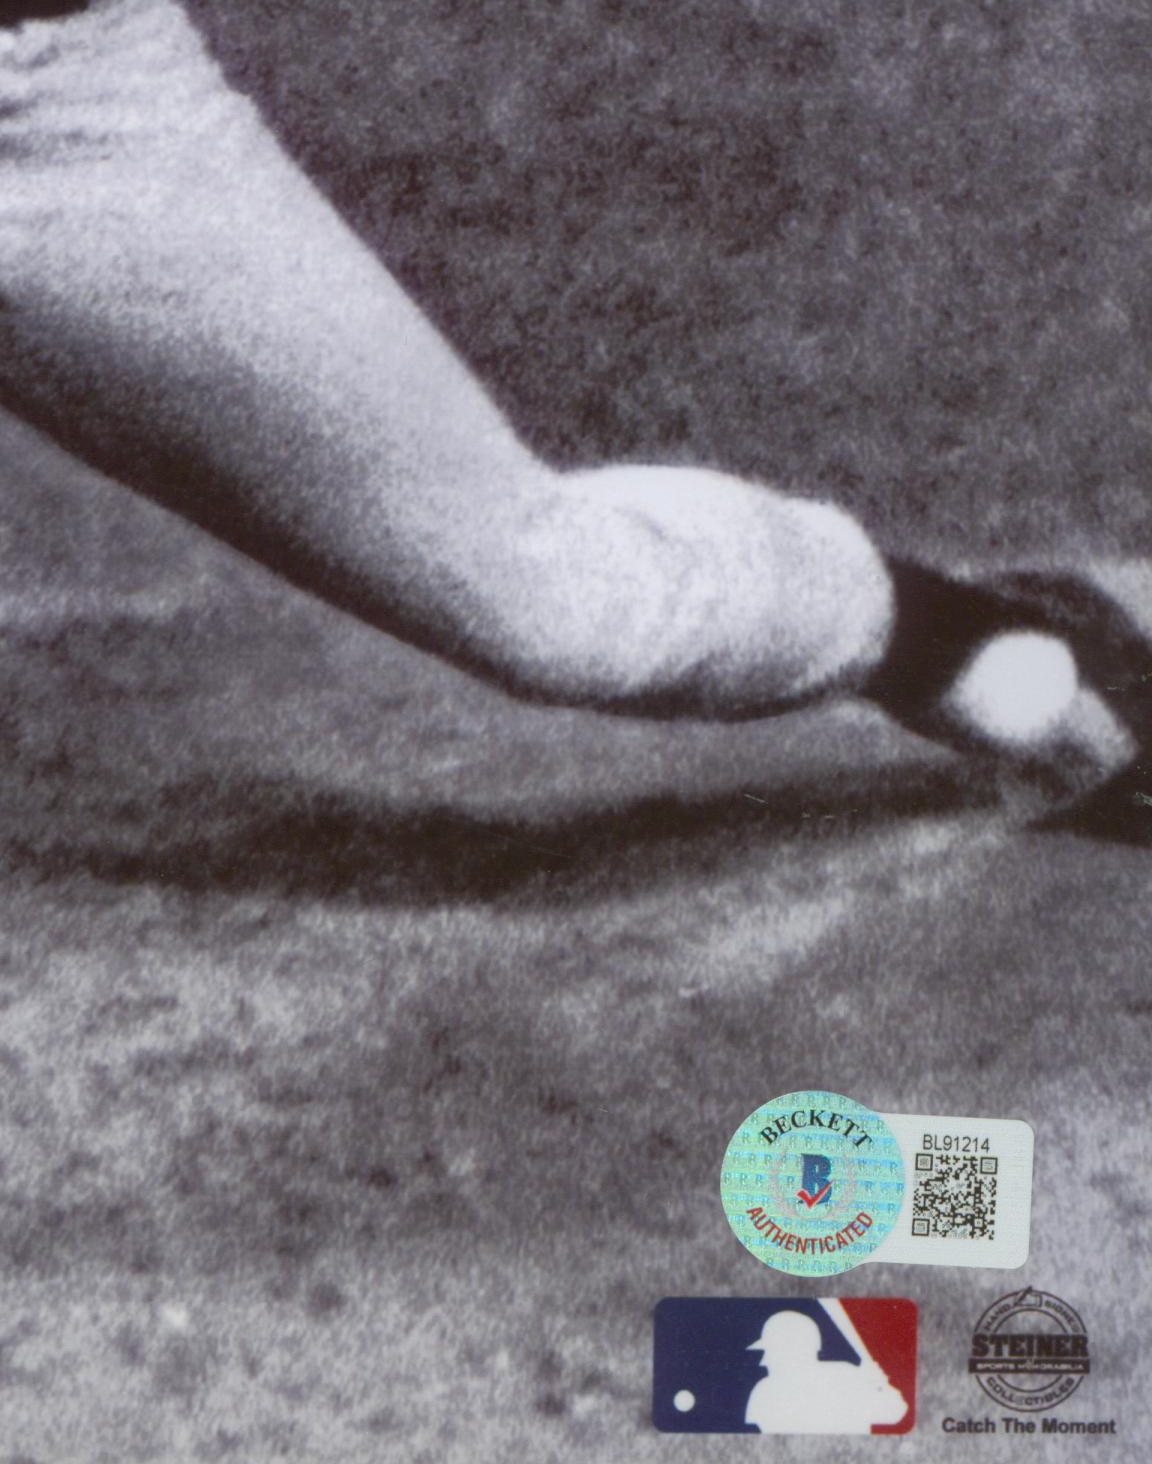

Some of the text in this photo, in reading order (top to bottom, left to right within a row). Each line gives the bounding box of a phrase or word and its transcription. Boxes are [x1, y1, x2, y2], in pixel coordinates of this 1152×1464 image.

[759, 1109, 873, 1148] BECKETT
[922, 1134, 991, 1153] BL91214
[745, 1207, 873, 1255] AUTHENTICATED
[972, 1333, 1089, 1357] STEINER
[986, 1376, 1075, 1405] COLLCTIBLES
[942, 1417, 1117, 1434] Catch The Moment
